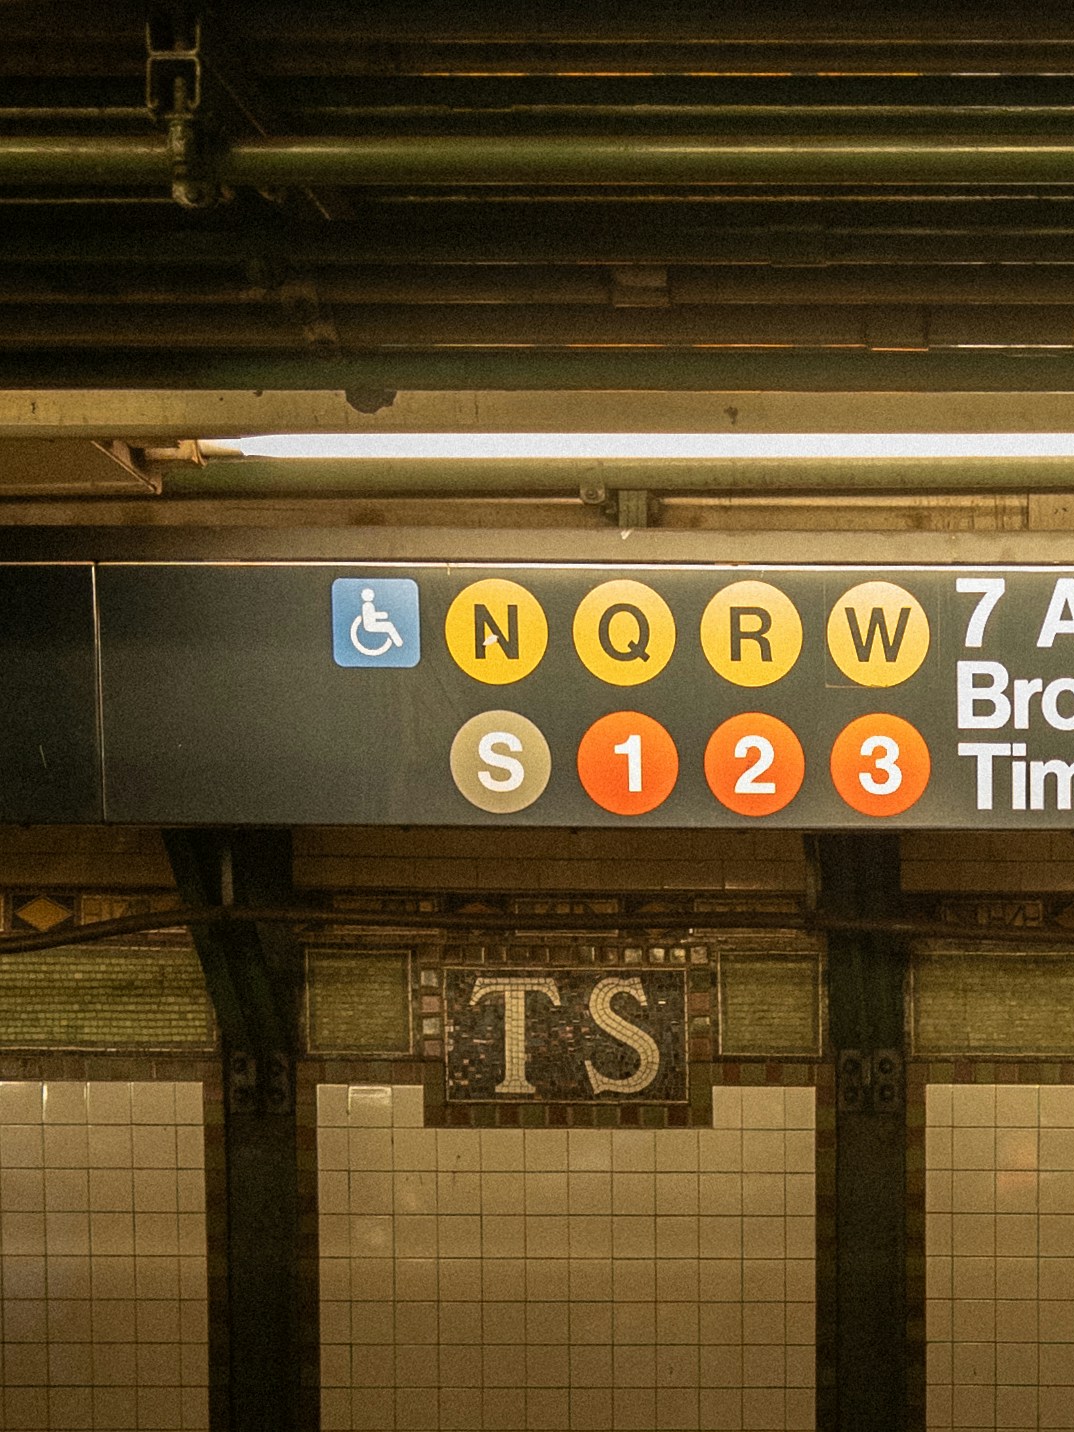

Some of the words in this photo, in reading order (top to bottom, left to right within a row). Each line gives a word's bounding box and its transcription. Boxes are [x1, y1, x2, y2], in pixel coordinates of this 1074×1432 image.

[474, 603, 519, 661] N
[598, 602, 652, 663] Q
[729, 605, 773, 663] R
[845, 606, 912, 663] W
[956, 577, 1006, 648] 7
[477, 731, 525, 793] S
[613, 734, 644, 793] 1
[733, 735, 777, 795] 2
[858, 735, 903, 796] 3
[469, 977, 661, 1094] TS
